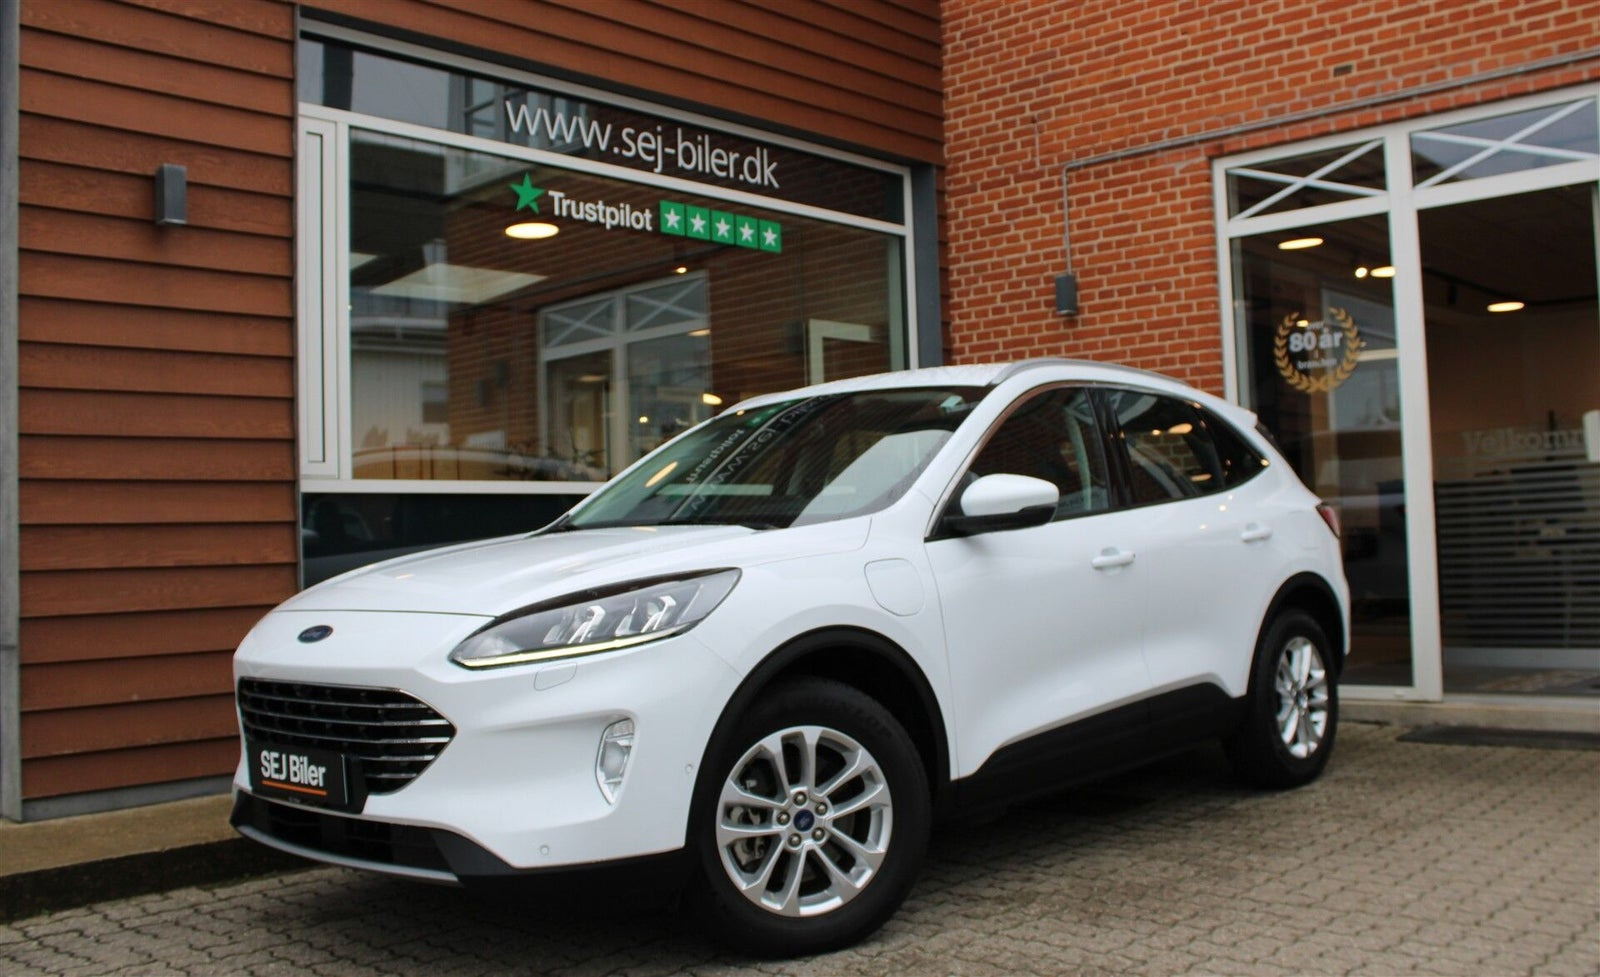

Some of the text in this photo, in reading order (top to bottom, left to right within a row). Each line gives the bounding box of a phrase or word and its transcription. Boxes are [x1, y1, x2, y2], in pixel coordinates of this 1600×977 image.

[505, 100, 780, 189] www.sej-biler.dk
[548, 190, 653, 231] Trustpilot
[1289, 327, 1343, 352] 80 år
[260, 750, 326, 787] SEJ Biler
